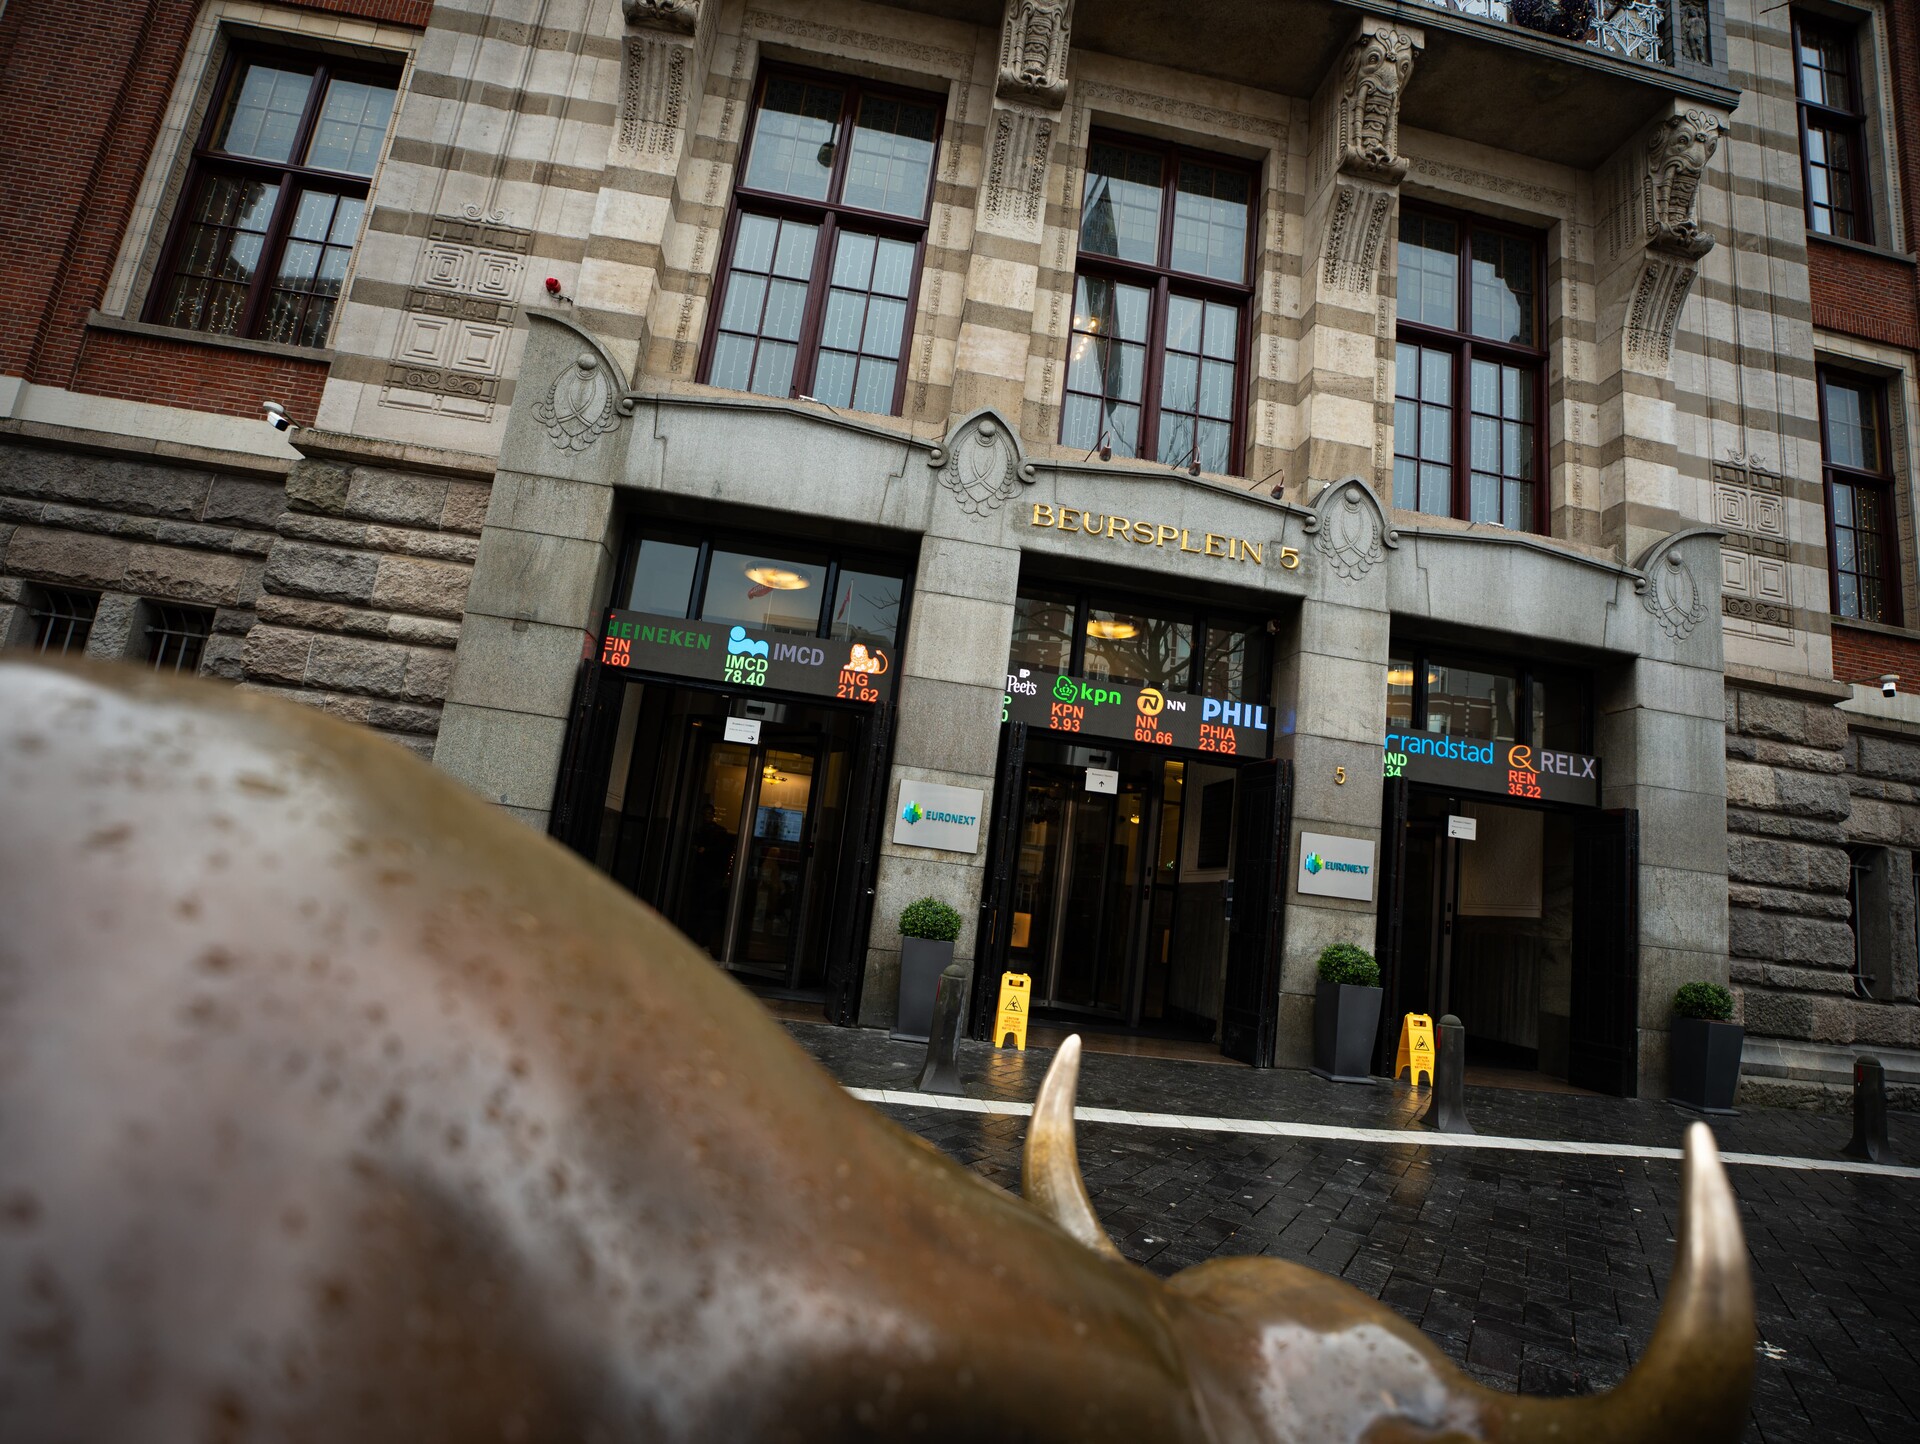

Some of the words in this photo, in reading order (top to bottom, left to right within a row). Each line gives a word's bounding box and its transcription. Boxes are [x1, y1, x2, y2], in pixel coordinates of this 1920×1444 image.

[1031, 503, 1263, 565] BEURSPLEIN
[1280, 546, 1300, 570] 5
[607, 620, 712, 650] HEINEKEN
[773, 643, 825, 666] IMCD
[725, 655, 769, 673] IMCD
[724, 669, 766, 687] 78.40
[839, 671, 869, 687] ING
[836, 685, 879, 702] 21.62
[1080, 682, 1122, 706] kpn
[1051, 703, 1084, 720] KPN
[1166, 699, 1187, 712] NN
[1202, 697, 1267, 730] PHIL
[1050, 717, 1081, 733] 3.93
[1135, 715, 1158, 730] NN
[1134, 728, 1173, 746] 60.66
[1200, 724, 1236, 741] PHIA
[1198, 737, 1237, 755] 23.62
[1401, 735, 1494, 765] randstad
[1540, 751, 1596, 780] RELX
[1334, 766, 1346, 786] 5
[1508, 770, 1536, 786] REN
[1508, 783, 1542, 799] 35.22
[925, 810, 976, 826] EURONEXT
[1325, 861, 1370, 875] EURONEXT
